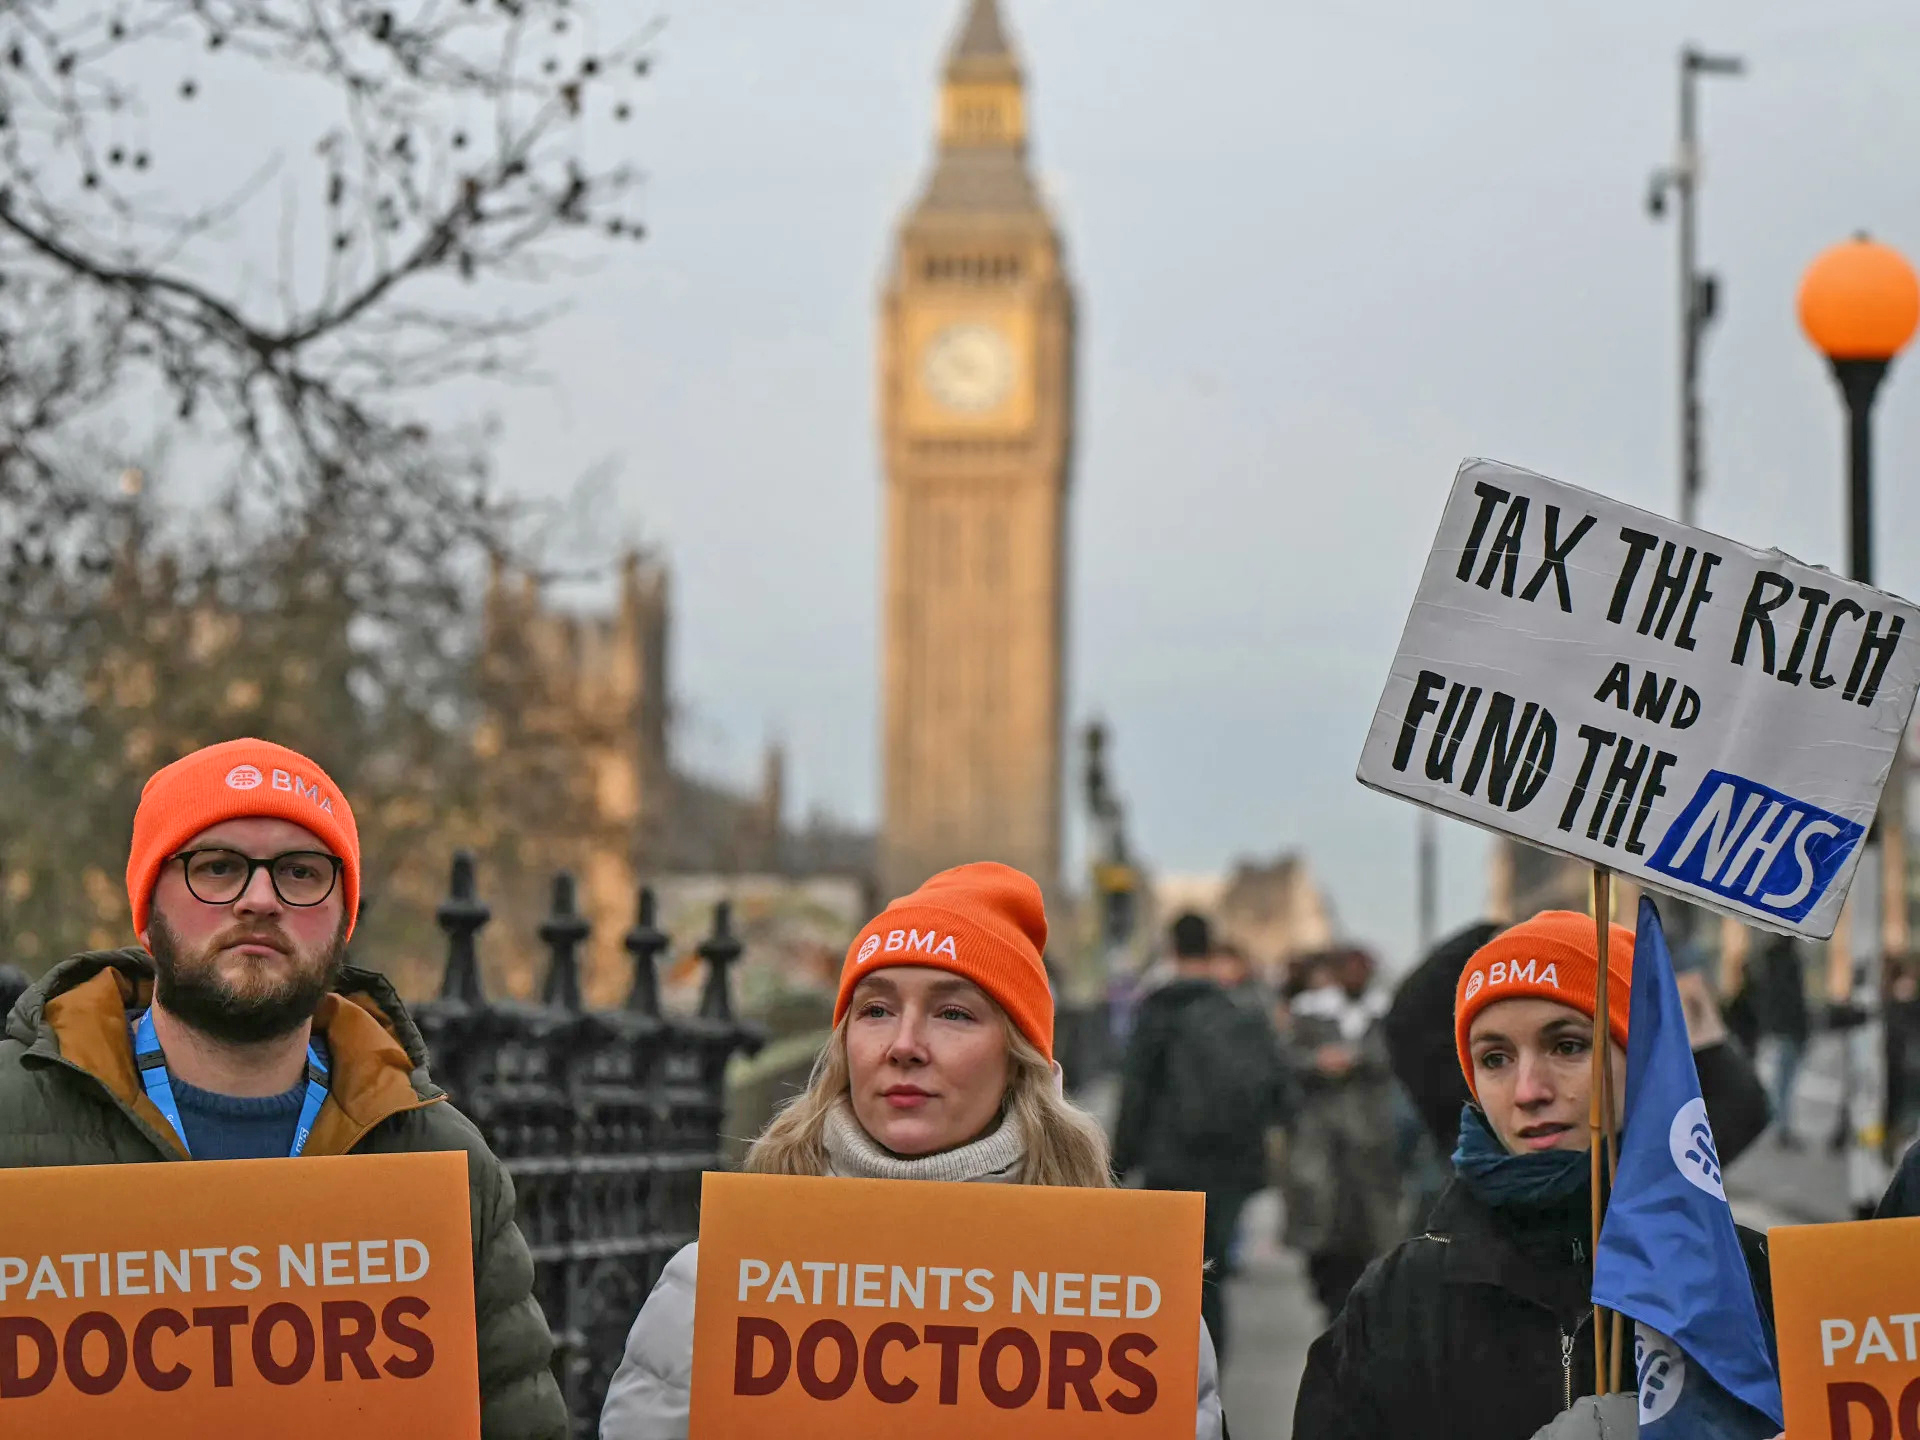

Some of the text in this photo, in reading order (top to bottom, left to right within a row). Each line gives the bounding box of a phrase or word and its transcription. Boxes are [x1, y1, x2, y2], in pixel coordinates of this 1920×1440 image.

[1455, 480, 1907, 708] TAX THE RICH
[1593, 661, 1701, 730] AND
[271, 767, 334, 816] BMA
[1391, 669, 1841, 910] FUND THE NHS
[884, 928, 957, 961] BMA
[1488, 959, 1560, 989] BMA
[0, 1238, 430, 1301] PATIENTS NEED
[737, 1258, 1162, 1319] PATIENTS NEED
[0, 1296, 435, 1399] DOCTORS
[733, 1316, 1158, 1415] DOCTORS
